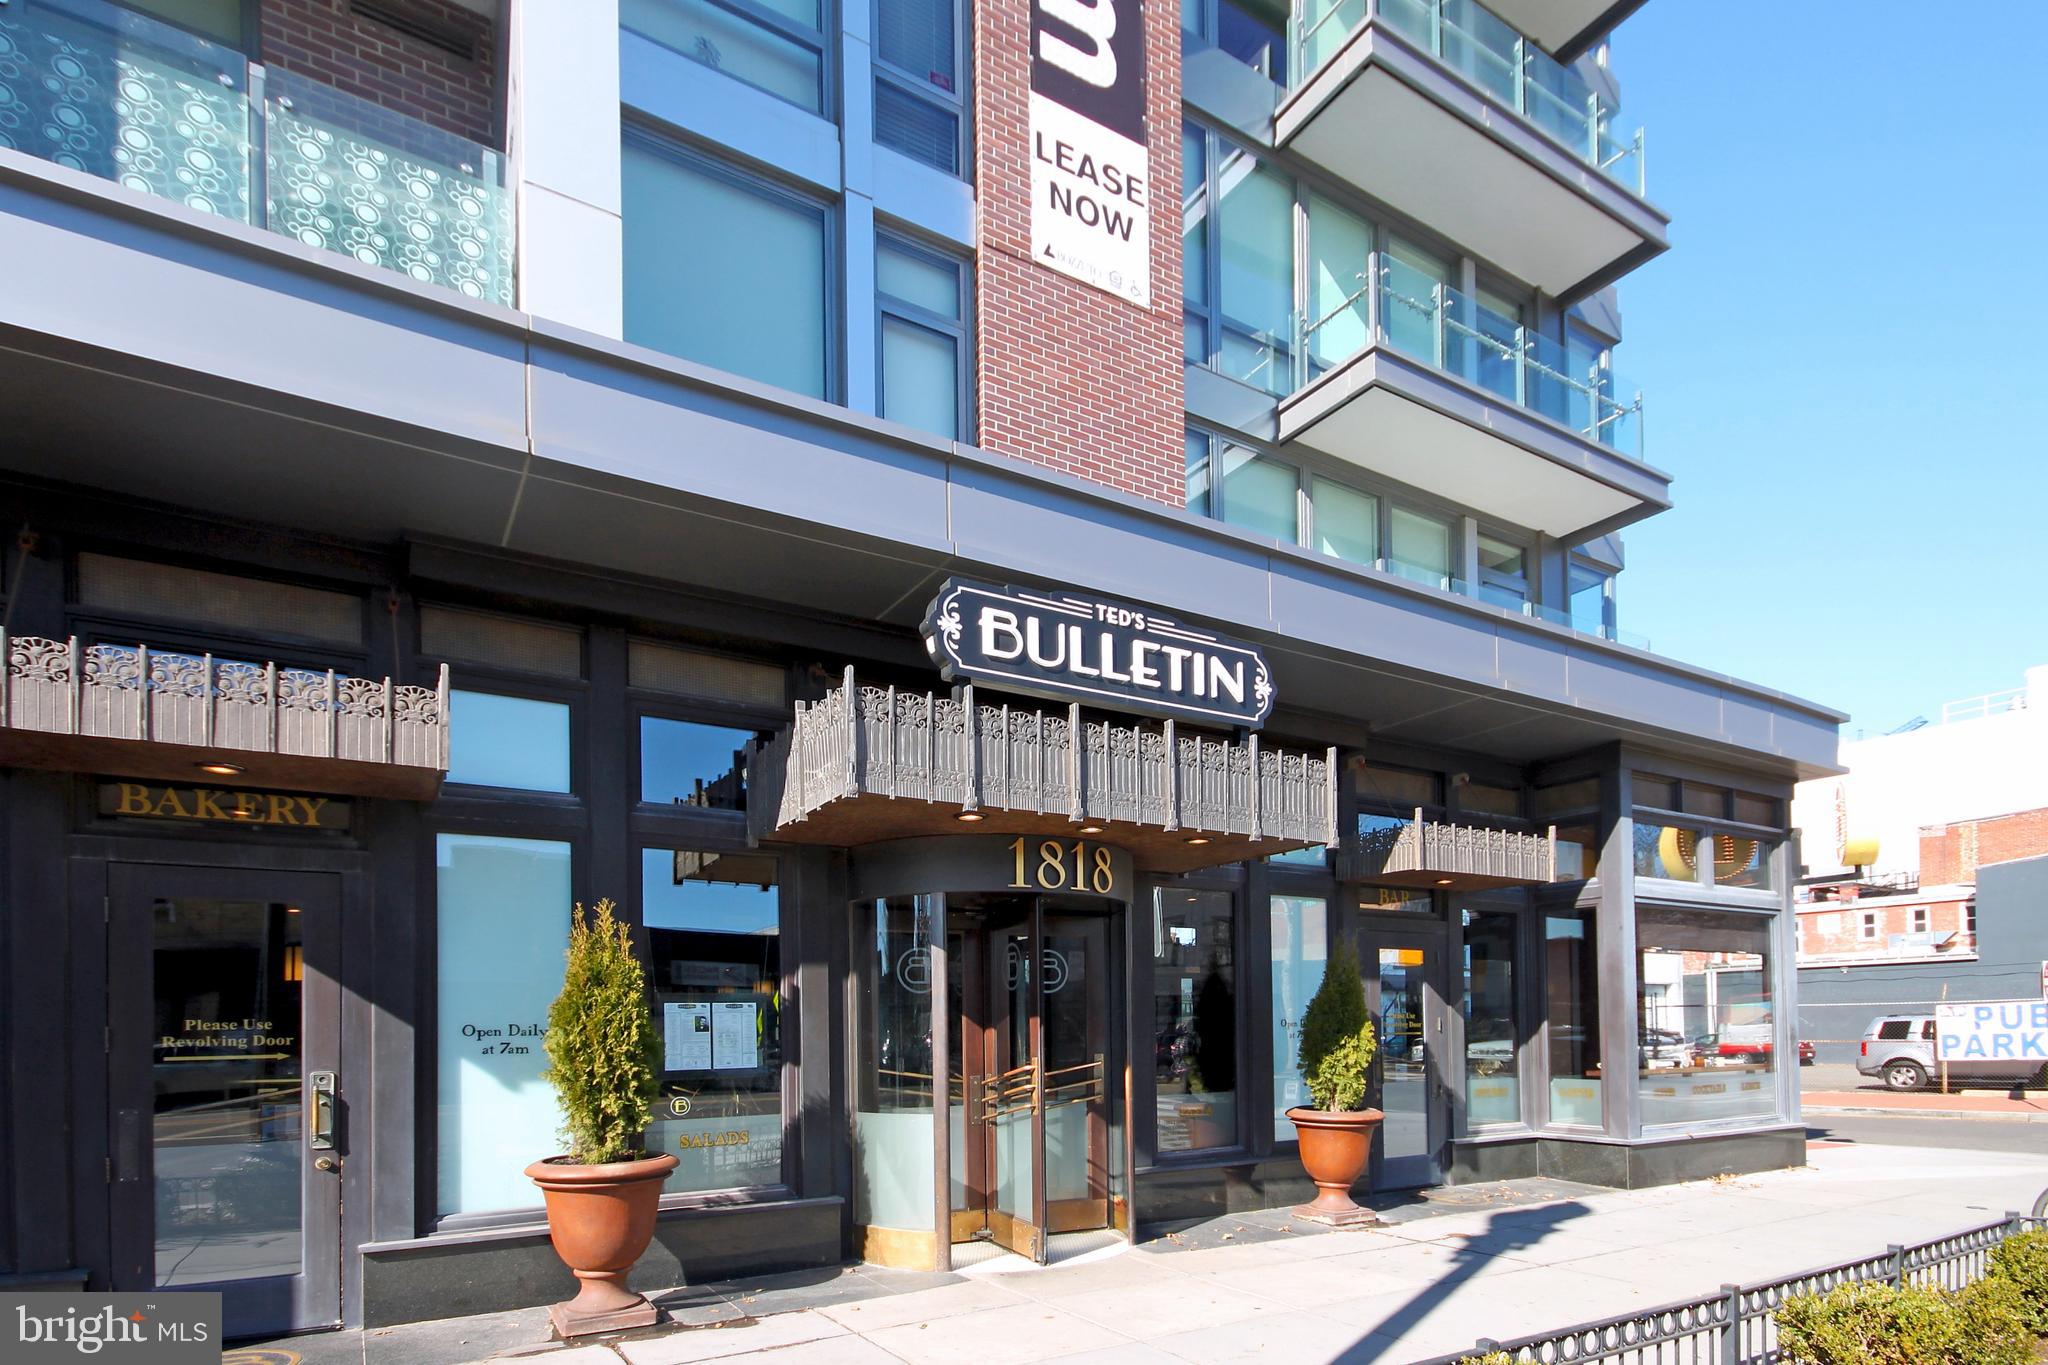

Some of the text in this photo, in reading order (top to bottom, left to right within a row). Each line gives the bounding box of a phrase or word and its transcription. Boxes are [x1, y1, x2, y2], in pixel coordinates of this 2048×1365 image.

[1036, 130, 1145, 208] LEASE
[1050, 180, 1134, 243] NOW
[1095, 603, 1146, 630] TED'S
[978, 606, 1245, 704] BULLETIN
[115, 782, 329, 827] BAKERY
[1008, 837, 1113, 894] 1818
[1378, 888, 1410, 906] BAR
[185, 1018, 273, 1031] Please Use
[462, 1023, 549, 1041] Open Daily
[161, 1034, 294, 1049] Revolving Door
[482, 1042, 529, 1055] at 7am
[680, 1129, 750, 1150] SALADS
